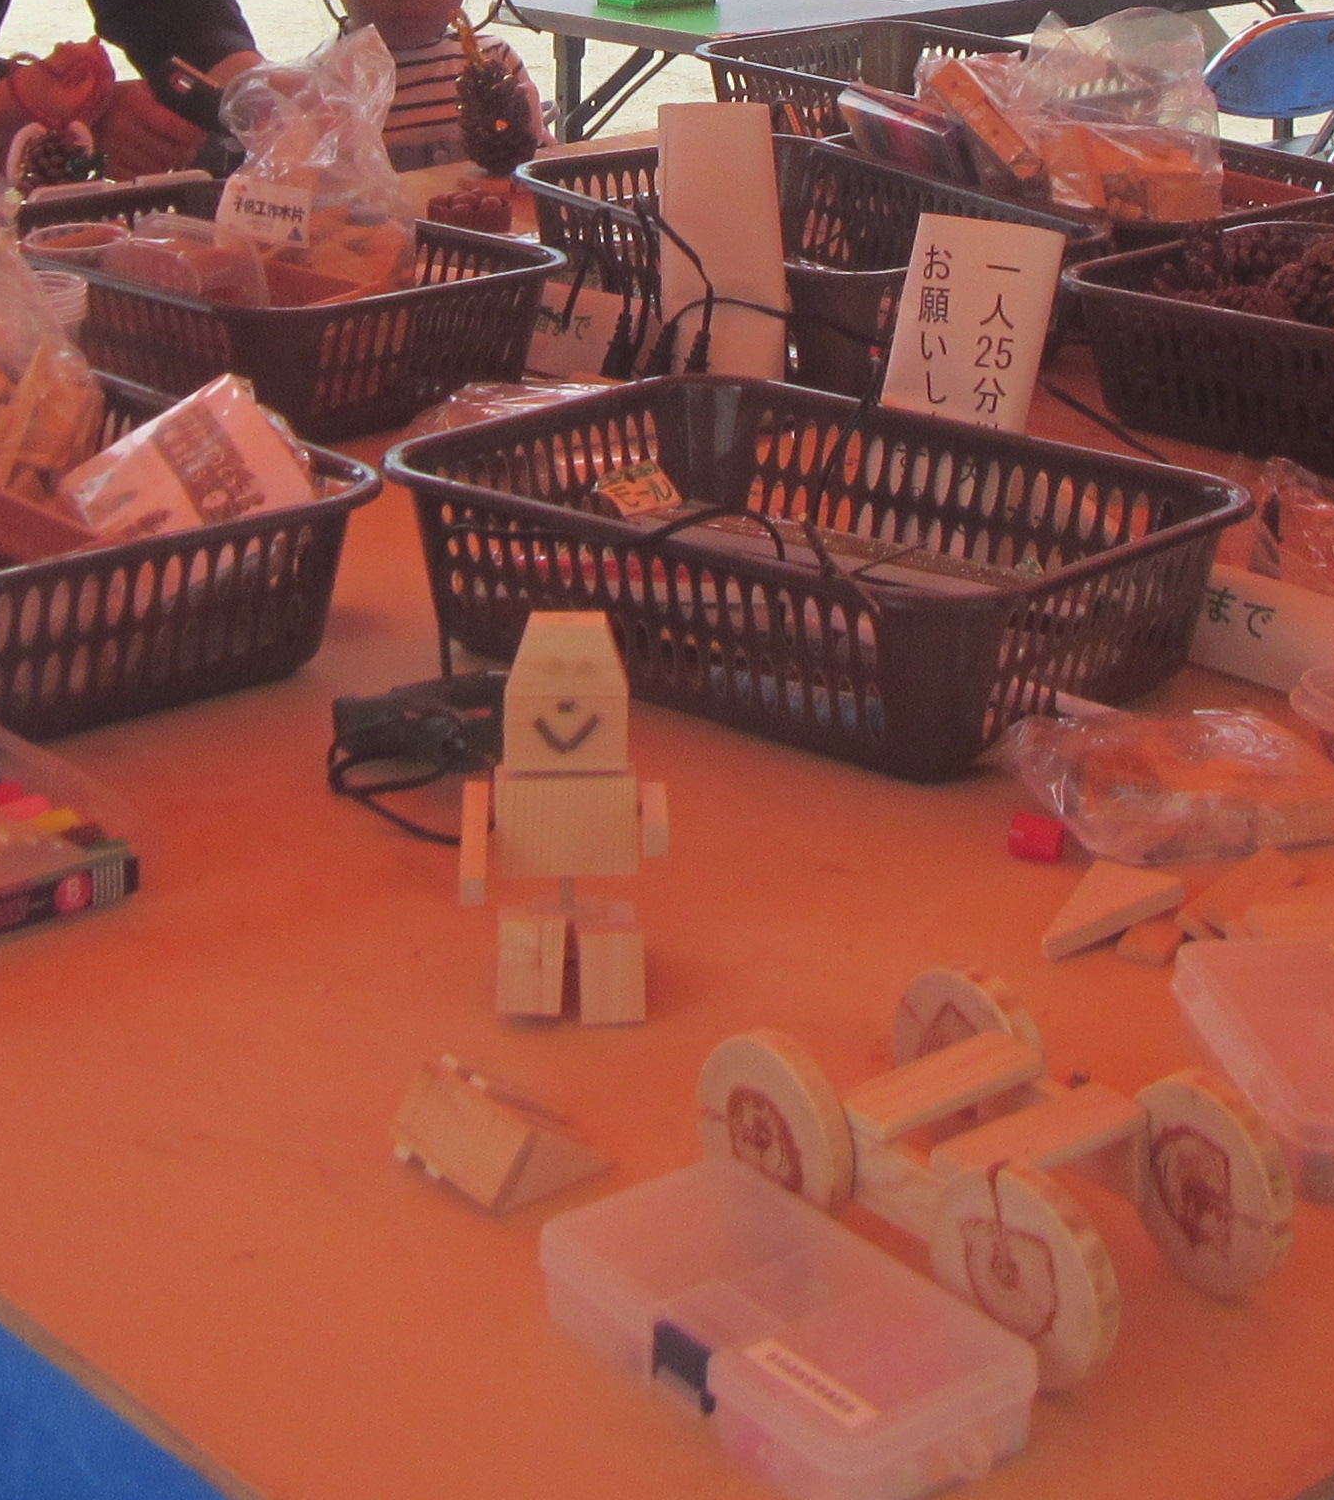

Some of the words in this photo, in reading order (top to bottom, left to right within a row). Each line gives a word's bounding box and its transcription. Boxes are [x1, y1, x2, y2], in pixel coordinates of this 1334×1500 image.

[918, 244, 953, 417] お願いし
[973, 263, 1021, 431] 一人25分
